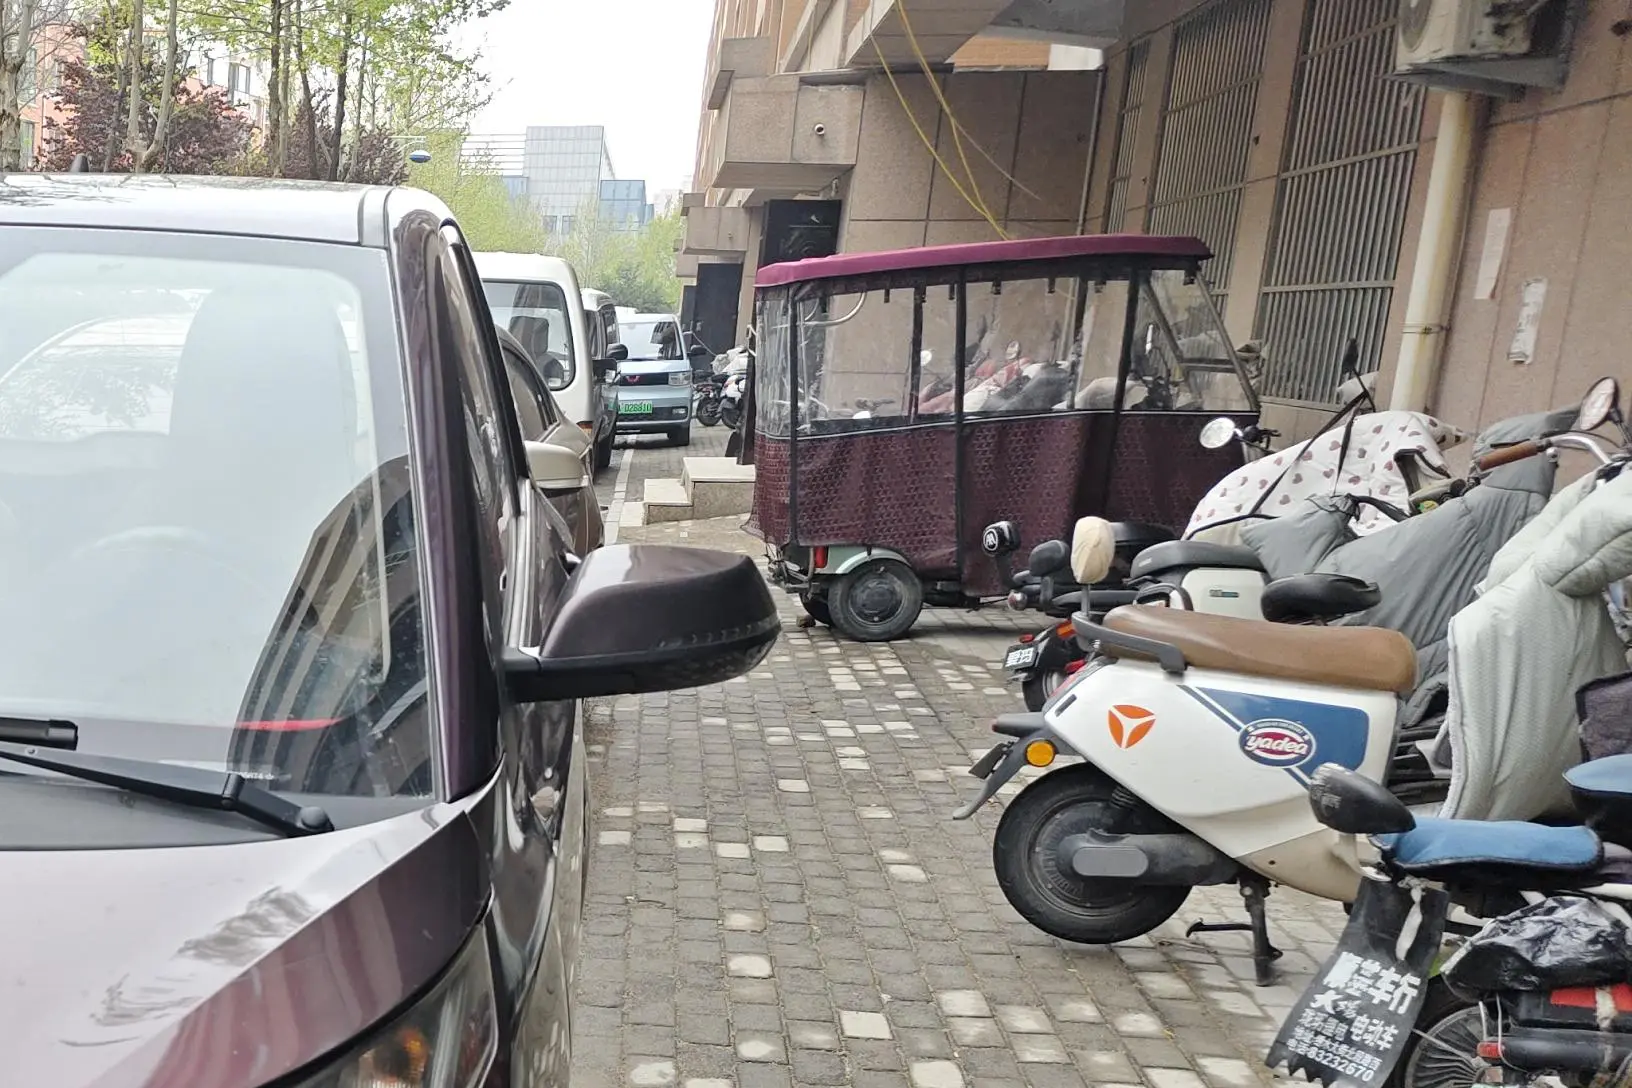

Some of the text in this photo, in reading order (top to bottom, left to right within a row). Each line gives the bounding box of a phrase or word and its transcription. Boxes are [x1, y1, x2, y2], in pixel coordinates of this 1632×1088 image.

[1244, 735, 1308, 755] yadea
[1350, 1013, 1399, 1051] 电动车
